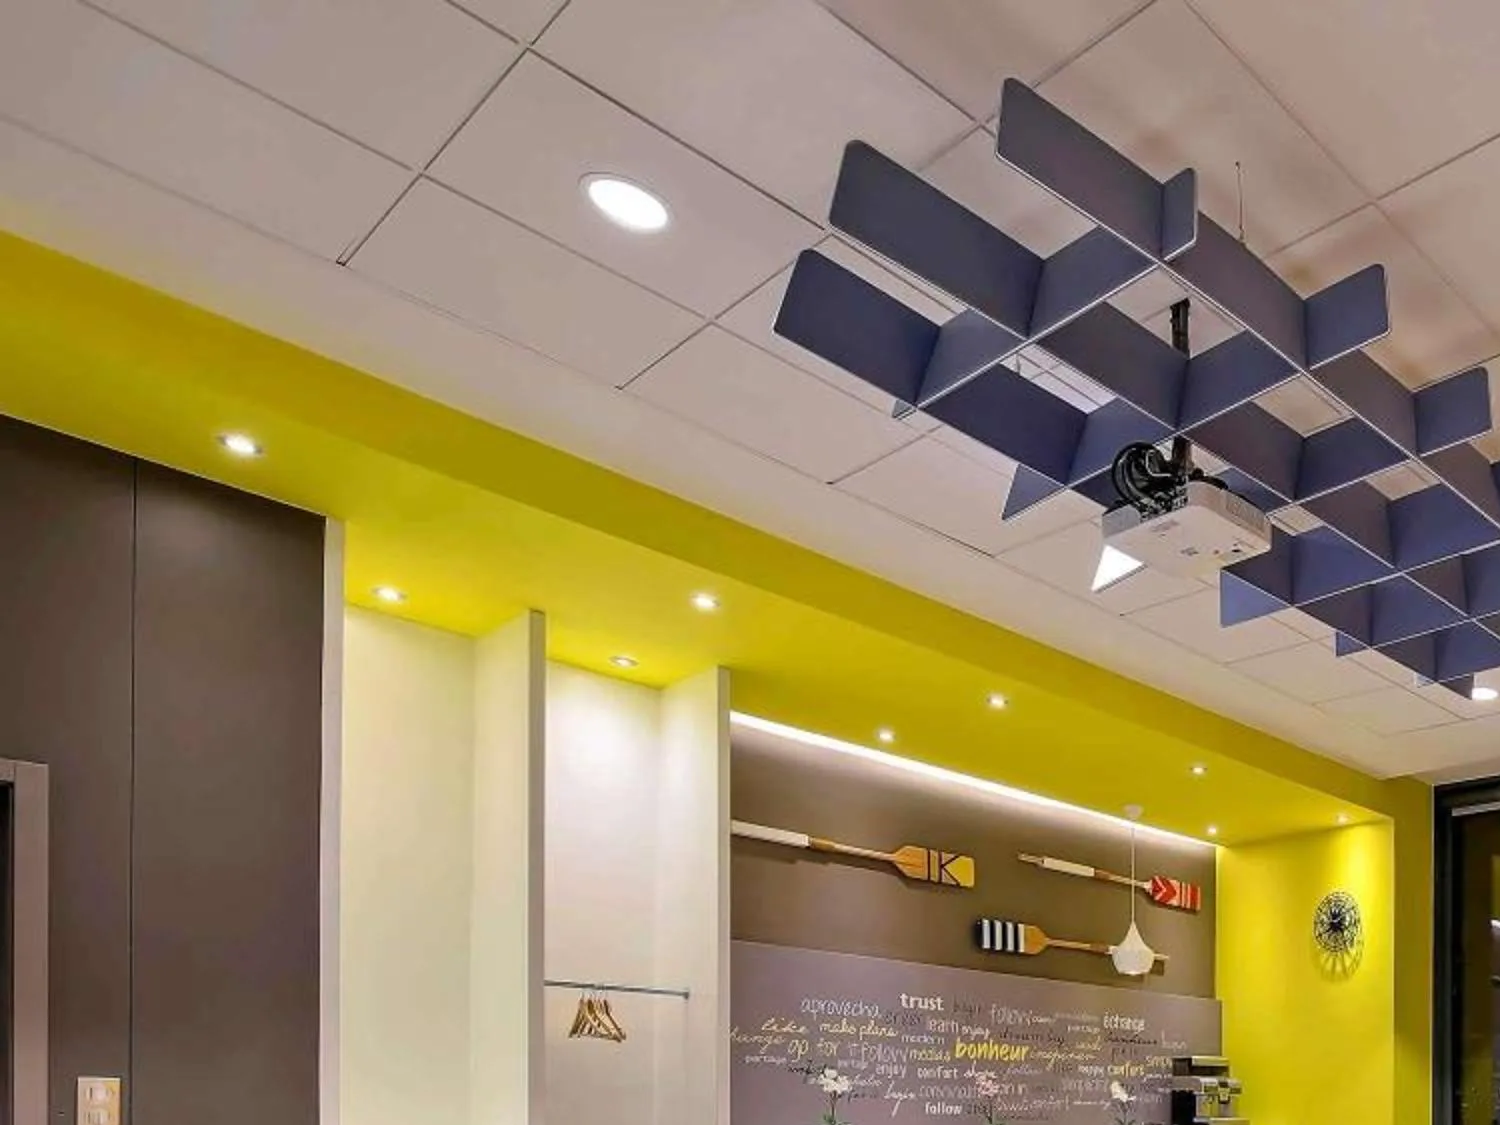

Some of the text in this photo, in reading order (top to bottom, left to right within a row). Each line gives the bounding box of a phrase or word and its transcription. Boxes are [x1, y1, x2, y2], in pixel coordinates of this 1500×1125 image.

[899, 992, 945, 1012] trust
[954, 1036, 1030, 1062] bonheur
[924, 1101, 963, 1115] follow
